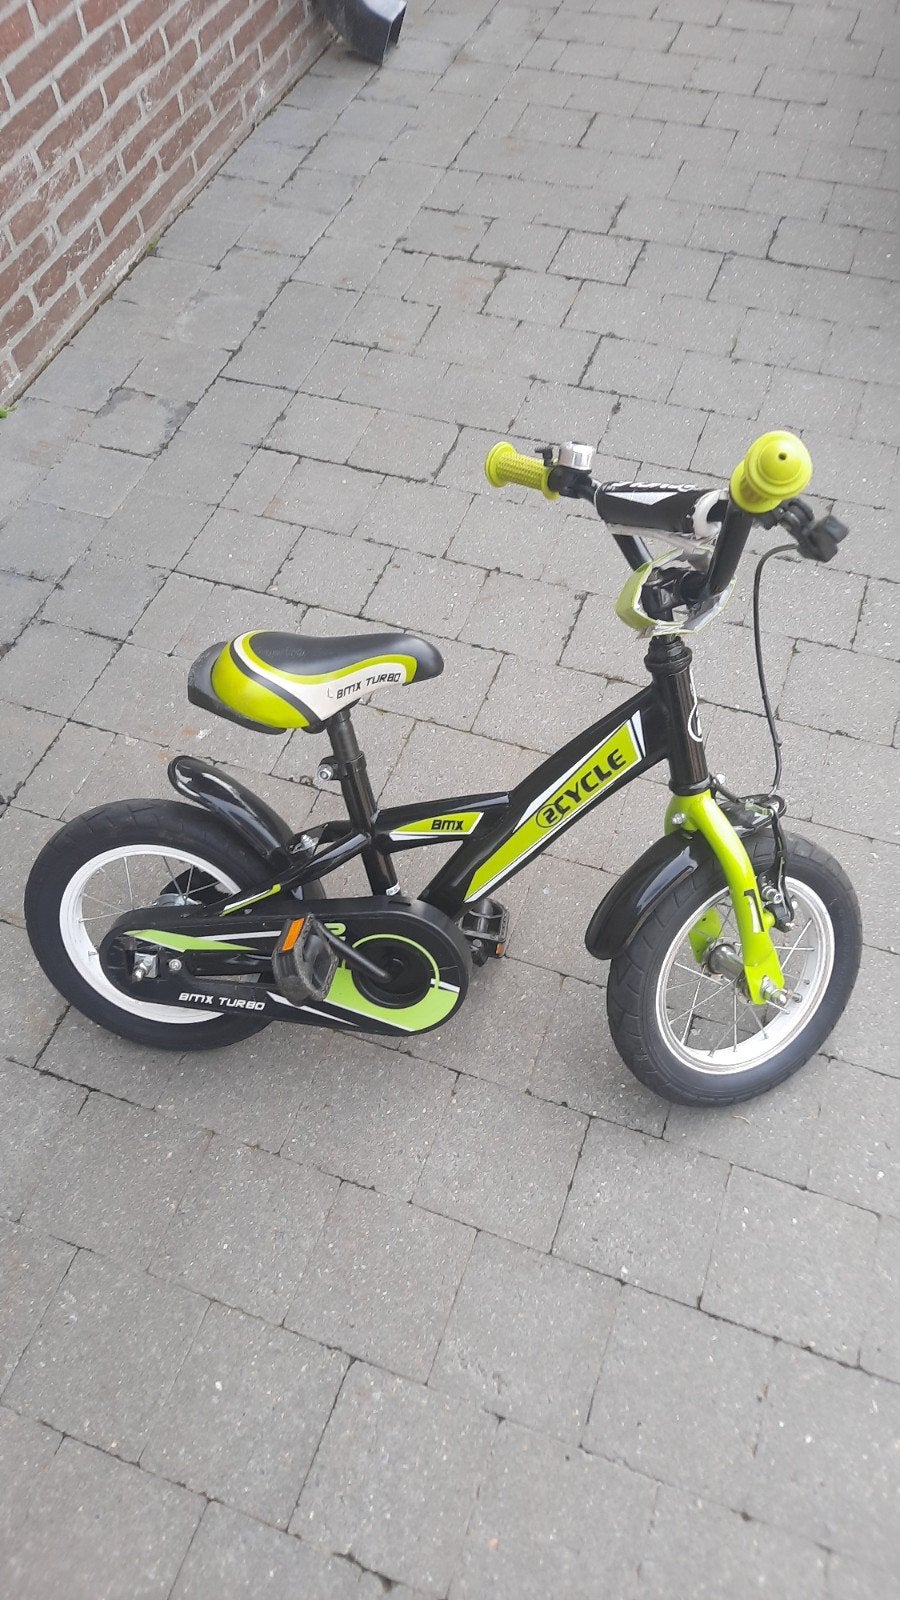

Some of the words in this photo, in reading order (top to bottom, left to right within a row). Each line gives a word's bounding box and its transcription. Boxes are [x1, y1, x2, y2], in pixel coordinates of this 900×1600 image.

[336, 681, 362, 699] BMX
[365, 672, 402, 687] TURBO
[431, 819, 464, 831] BMX
[178, 992, 214, 1005] BMX
[218, 997, 266, 1011] TURBO
